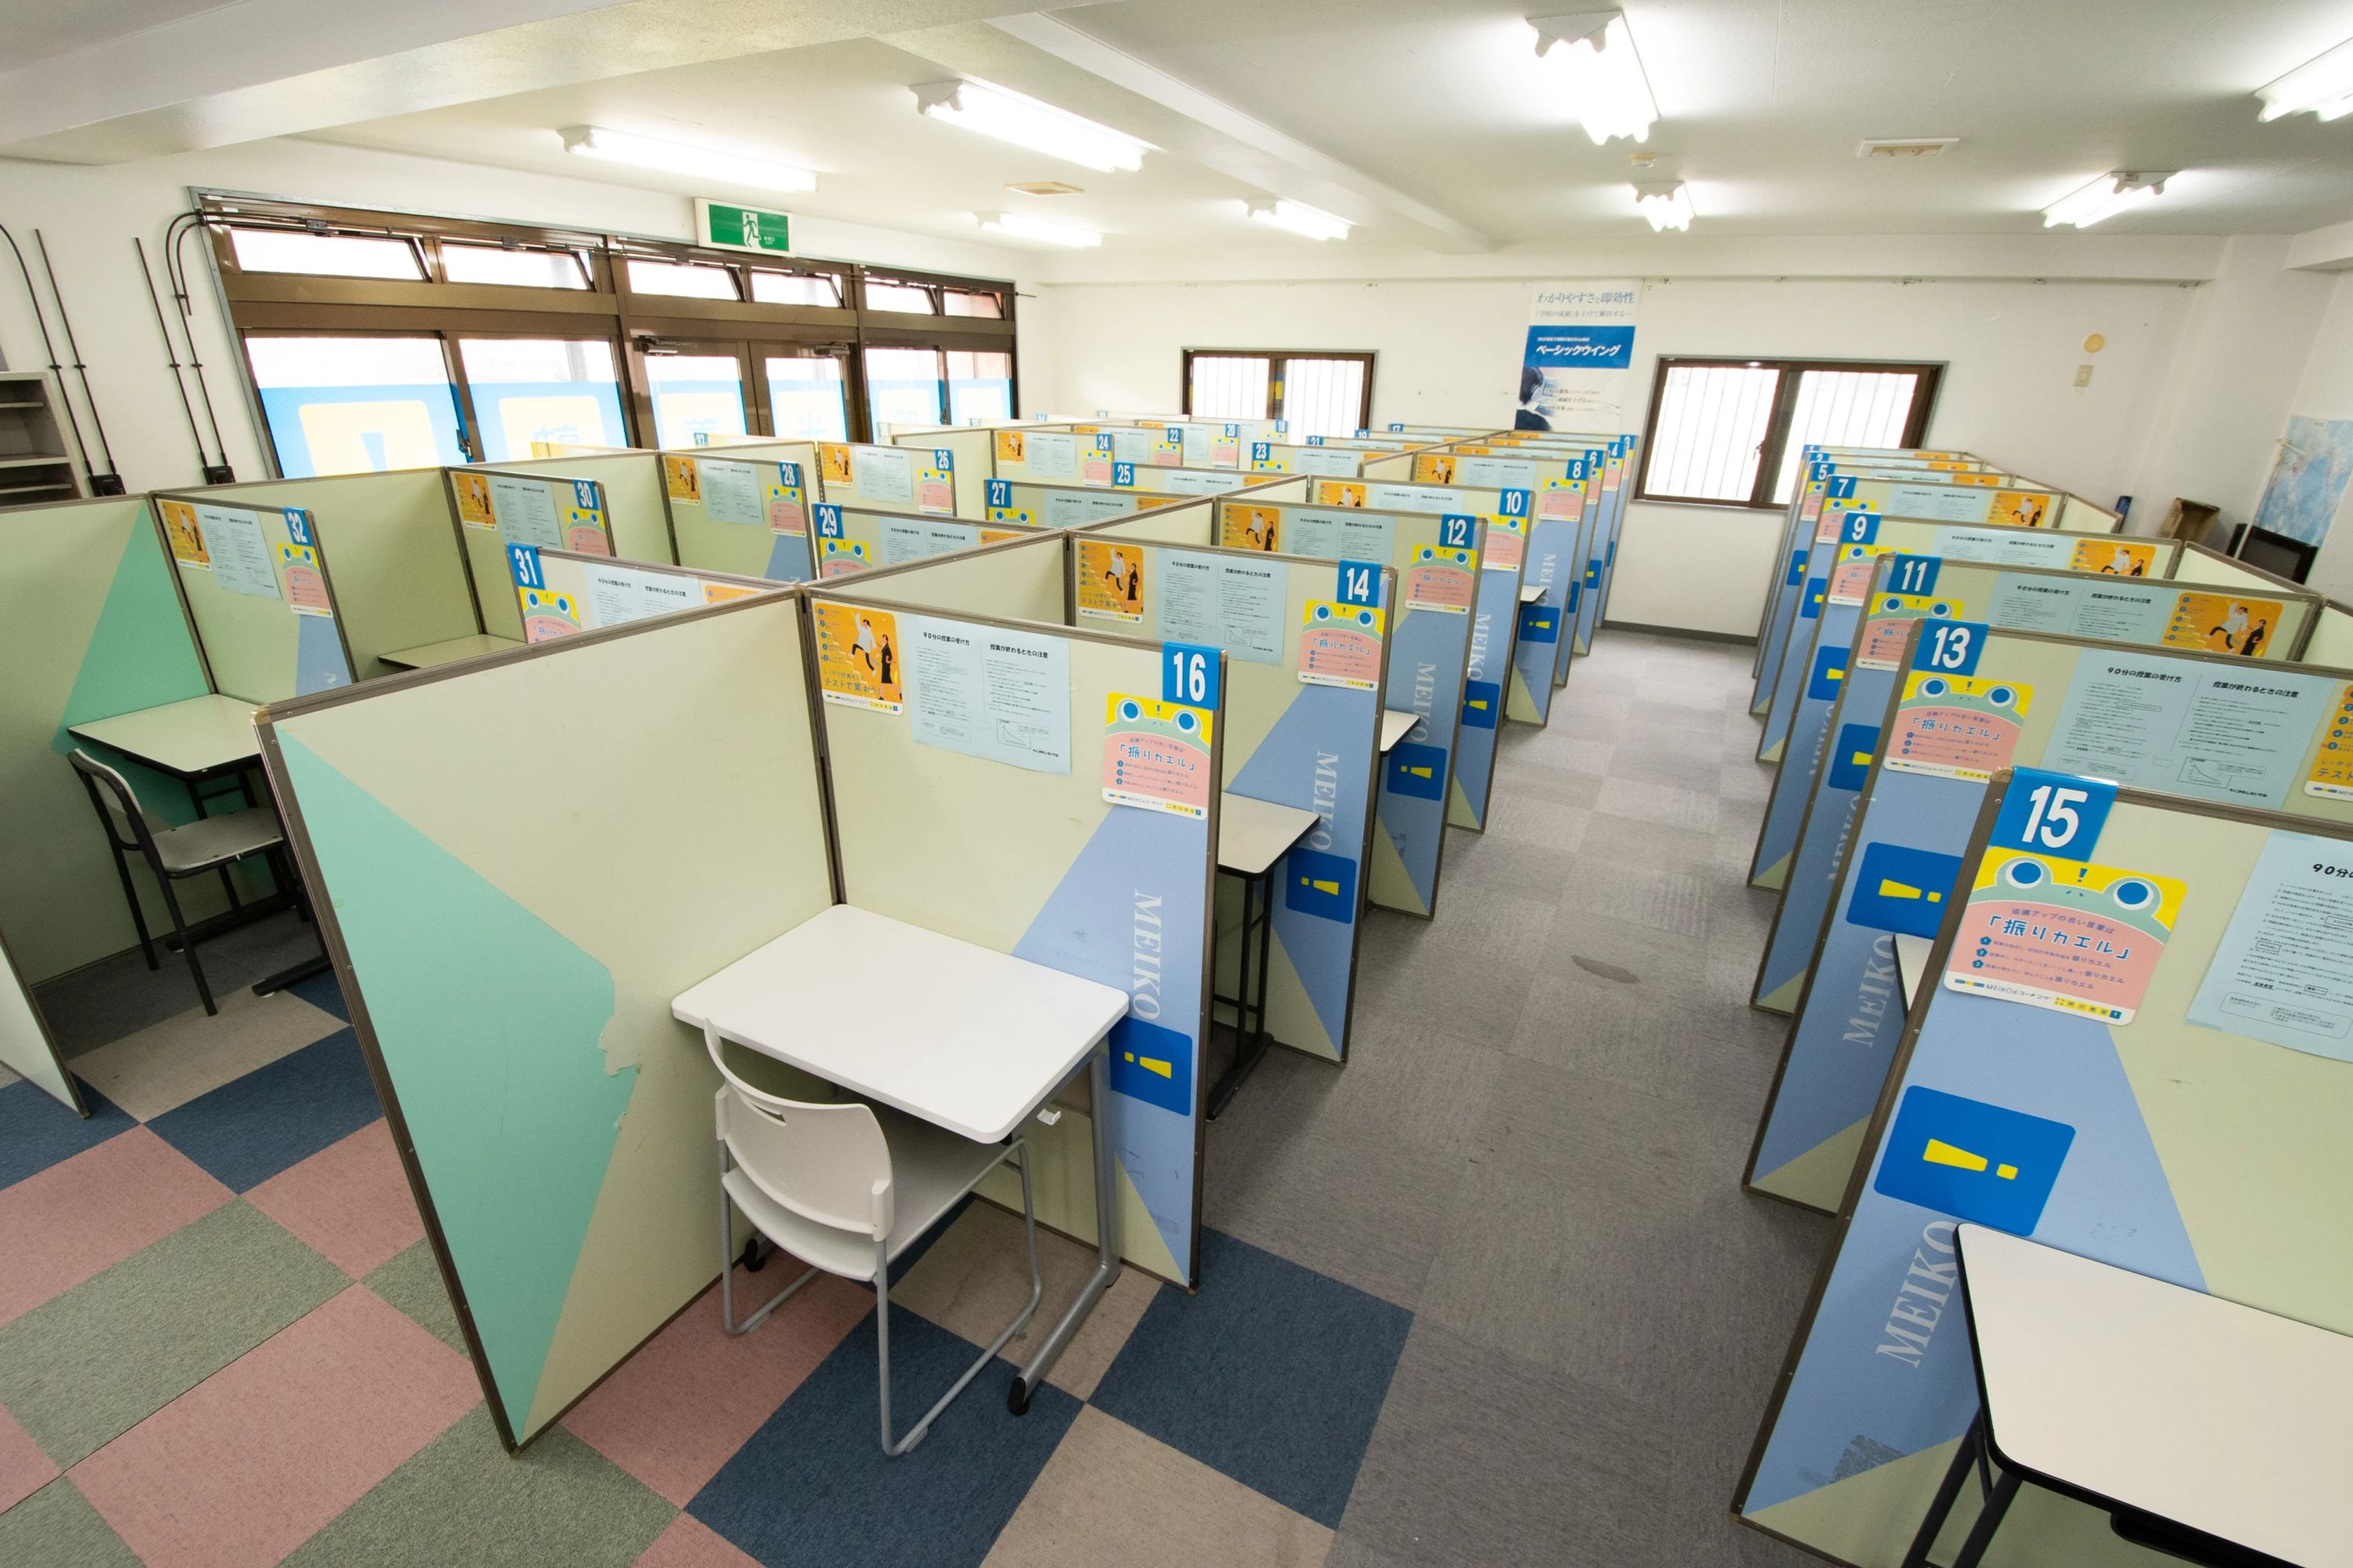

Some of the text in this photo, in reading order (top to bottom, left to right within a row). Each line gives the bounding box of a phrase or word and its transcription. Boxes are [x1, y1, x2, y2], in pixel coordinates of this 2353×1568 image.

[1537, 291, 1635, 304] わかりやすさと即効性
[1536, 344, 1622, 357] ベーシックウイング
[1169, 428, 1180, 443] 22
[1227, 424, 1236, 437] 20
[1278, 421, 1286, 432] 18
[1098, 435, 1109, 450] 24
[1256, 443, 1267, 460] 23
[936, 449, 949, 469] 26
[1573, 461, 1582, 478] 8
[1818, 464, 1828, 480] 5
[783, 464, 795, 486] 28
[1117, 464, 1131, 484] 25
[578, 482, 594, 508] 30
[992, 482, 1006, 504] 27
[1838, 478, 1849, 497] 7
[1506, 491, 1522, 514] 10
[288, 512, 308, 543] 32
[819, 507, 838, 537] 29
[1447, 518, 1467, 546] 12
[1852, 515, 1867, 541] 9
[515, 548, 538, 585] 31
[1902, 560, 1927, 591] 11
[1347, 567, 1369, 602] 14
[1468, 613, 1491, 681] MEIKO
[1932, 627, 1971, 669] 13
[1173, 651, 1206, 702] 16
[2107, 667, 2183, 684] 90分の授業の受け方
[1411, 661, 1437, 742] MEIKO
[2212, 681, 2299, 698] 授業が終わるときの注意
[1911, 717, 2001, 740] 「振りカエル」
[1119, 744, 1195, 771] 「振りカエル」
[1310, 750, 1339, 851] MEIKO
[2022, 785, 2088, 848] 15
[1989, 915, 2130, 960] 「振りカエル」
[1133, 890, 1162, 1020] MEIKO
[1842, 935, 1895, 1048] MEIKO
[1875, 1220, 1958, 1368] MEIKO
